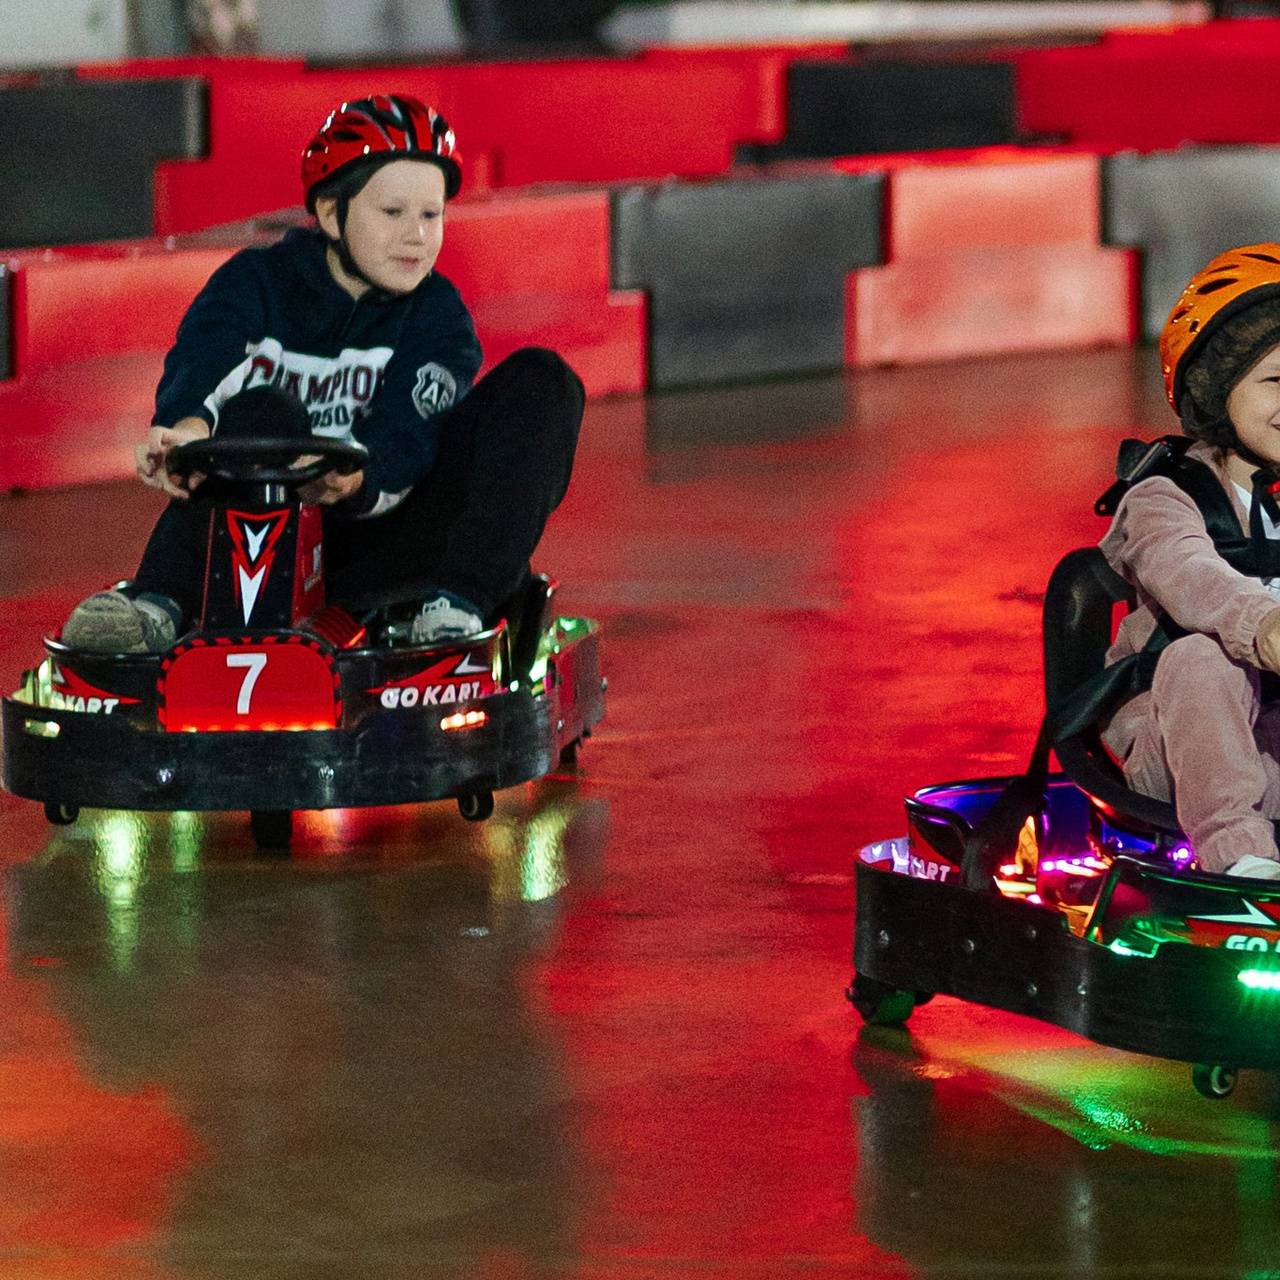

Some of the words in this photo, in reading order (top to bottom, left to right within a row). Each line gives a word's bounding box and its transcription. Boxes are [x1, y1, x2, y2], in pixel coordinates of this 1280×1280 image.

[226, 652, 267, 715] 7
[381, 686, 419, 709] GO
[422, 681, 480, 706] KART
